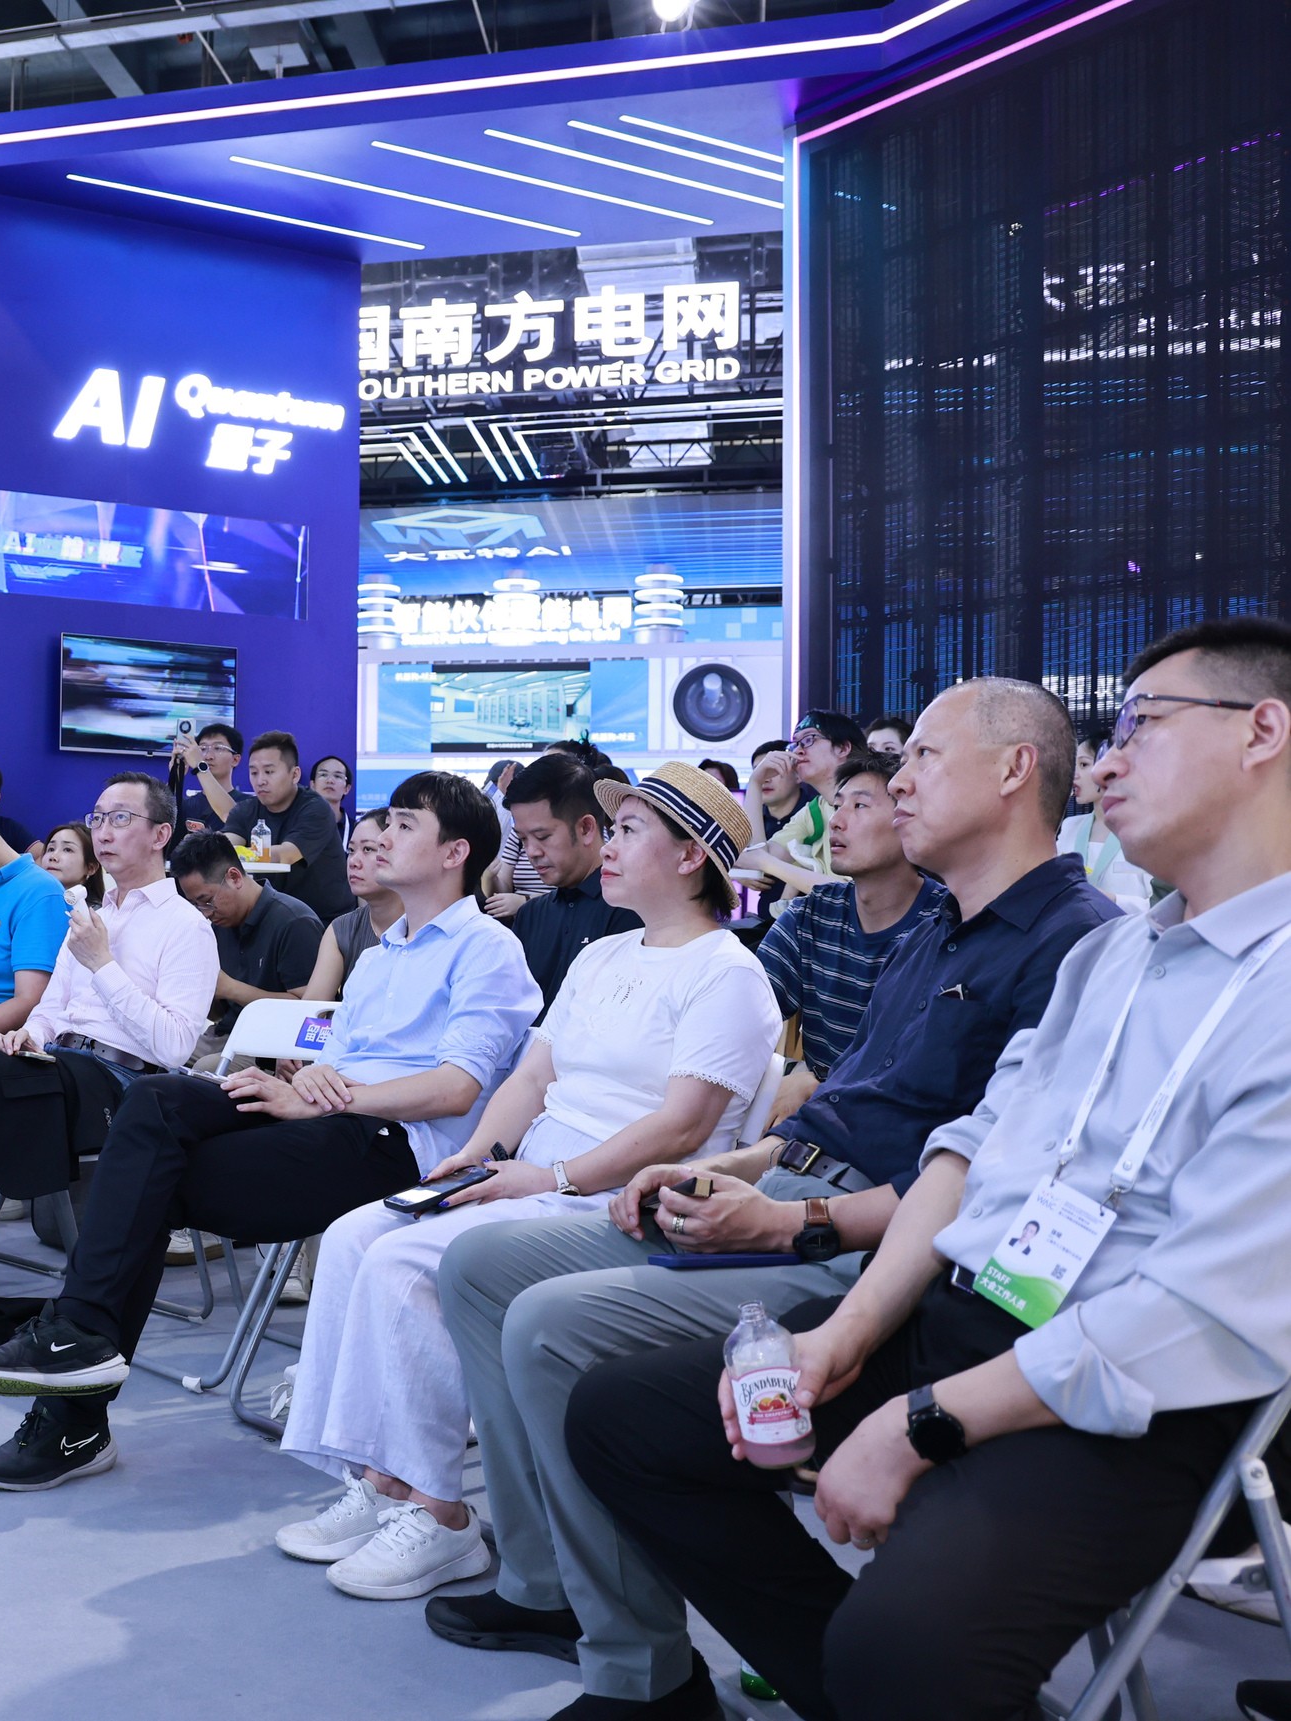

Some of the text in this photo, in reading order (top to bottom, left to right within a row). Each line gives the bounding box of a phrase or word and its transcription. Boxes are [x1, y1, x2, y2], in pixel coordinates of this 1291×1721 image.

[359, 357, 741, 400] OUTHERN POWER GRID
[52, 367, 166, 449] AI
[174, 373, 346, 432] Quantum
[526, 545, 572, 557] AI
[393, 597, 632, 633] 智能伙能电网
[987, 1266, 1011, 1286] STAFF
[740, 1376, 797, 1407] BUNDABERG
